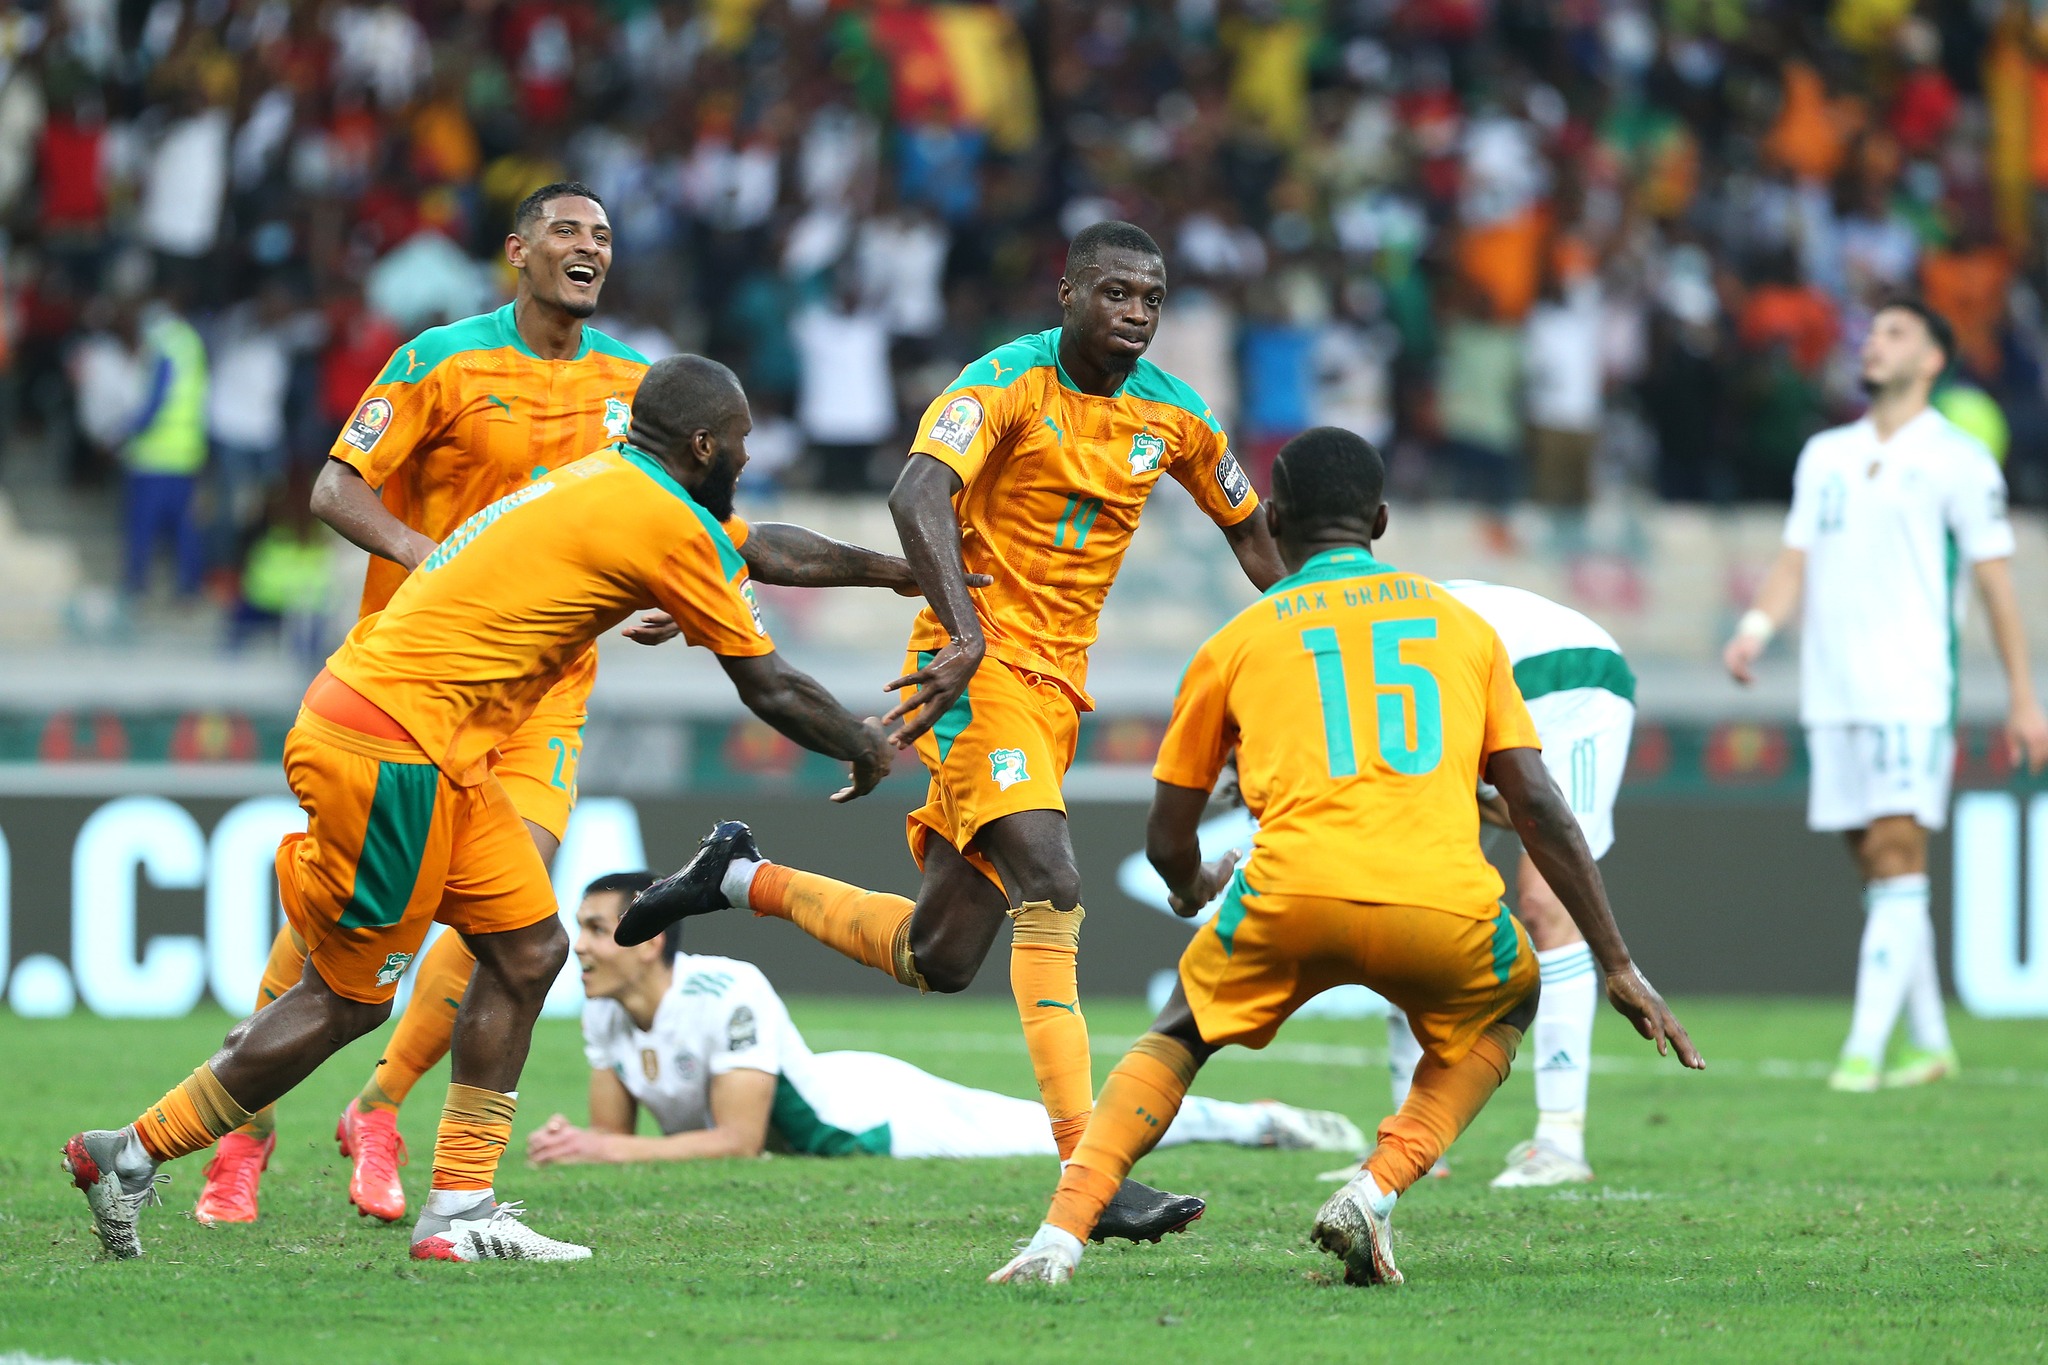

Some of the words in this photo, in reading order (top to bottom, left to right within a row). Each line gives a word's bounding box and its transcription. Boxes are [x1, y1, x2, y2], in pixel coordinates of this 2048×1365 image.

[1053, 492, 1104, 549] 19
[1274, 591, 1328, 620] MAX
[1301, 617, 1443, 778] 15
